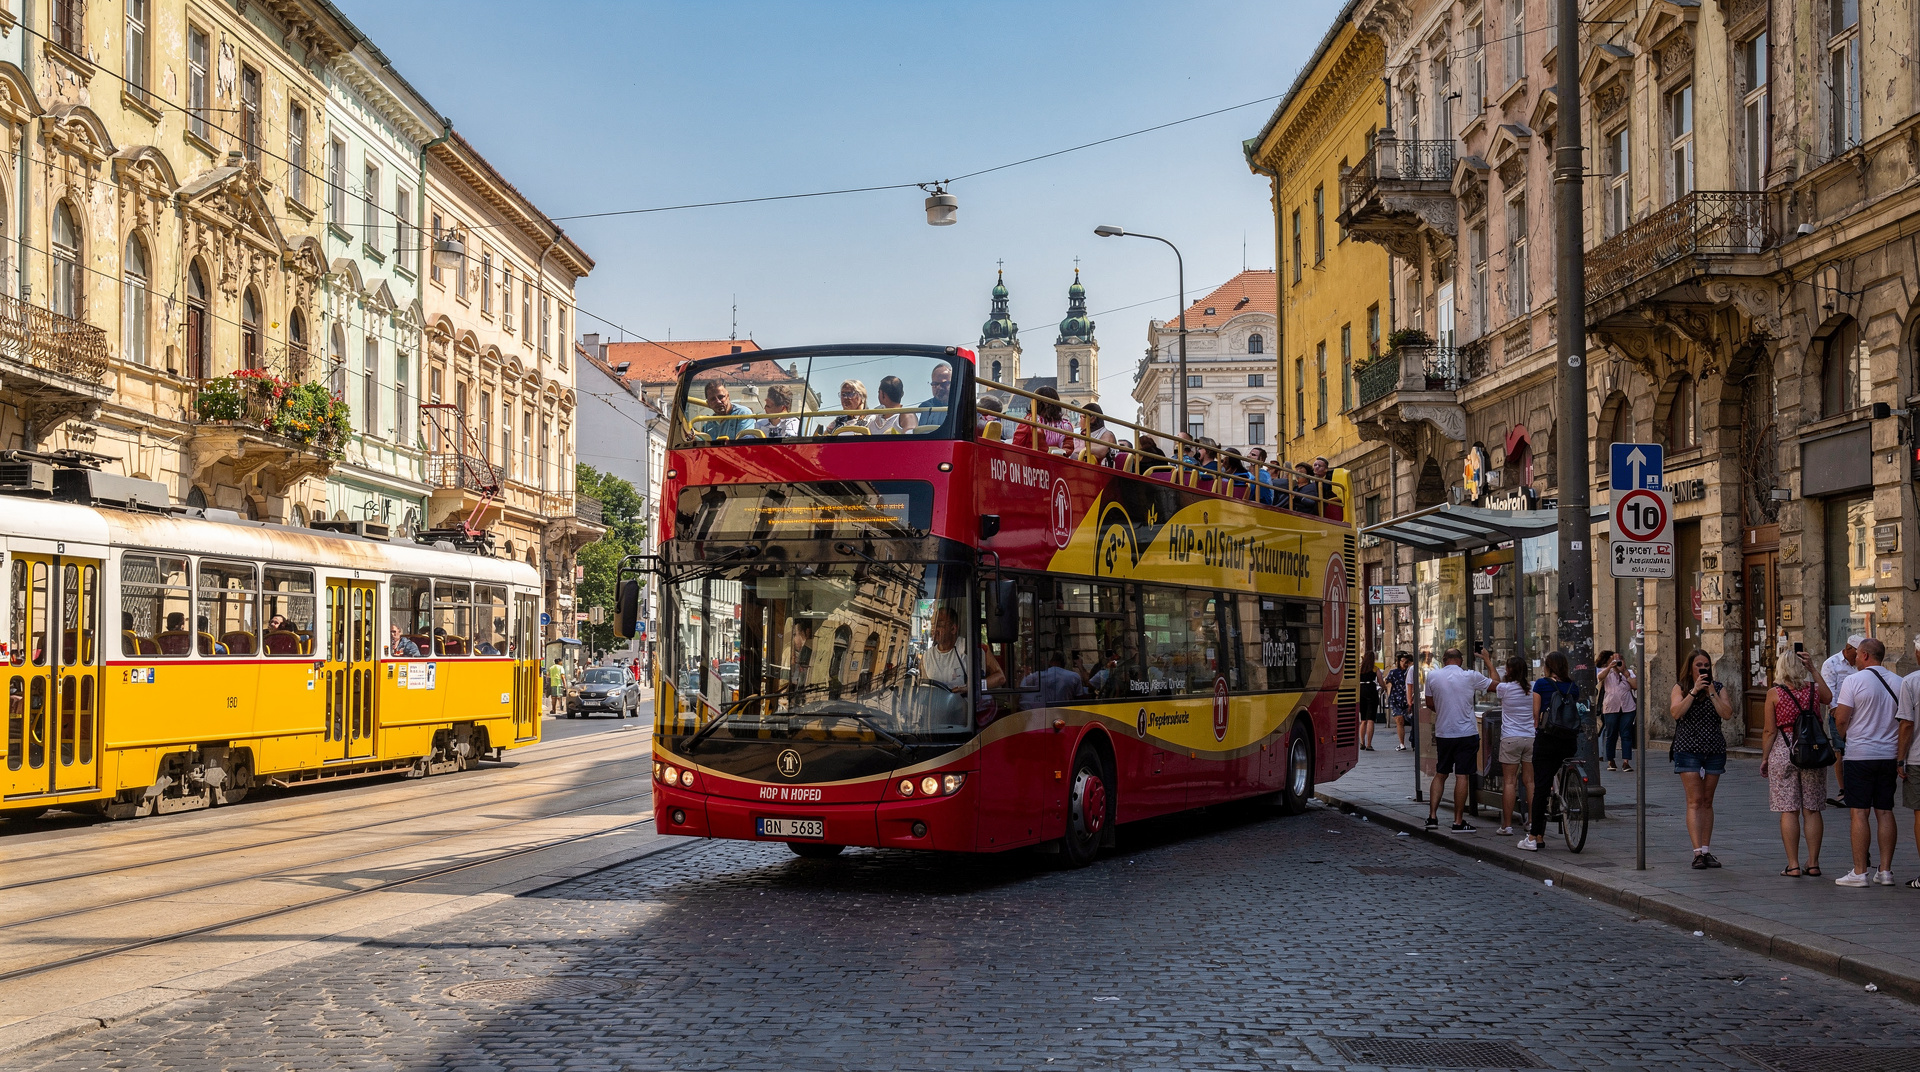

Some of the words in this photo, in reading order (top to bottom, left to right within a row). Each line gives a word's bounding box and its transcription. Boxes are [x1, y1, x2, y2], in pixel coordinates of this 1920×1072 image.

[991, 458, 1007, 481] HOP
[1009, 463, 1021, 484] ON
[1627, 503, 1659, 530] 10
[760, 787, 778, 799] HOP
[781, 788, 789, 800] N
[791, 788, 821, 801] HOPED
[791, 822, 822, 835] 5683
